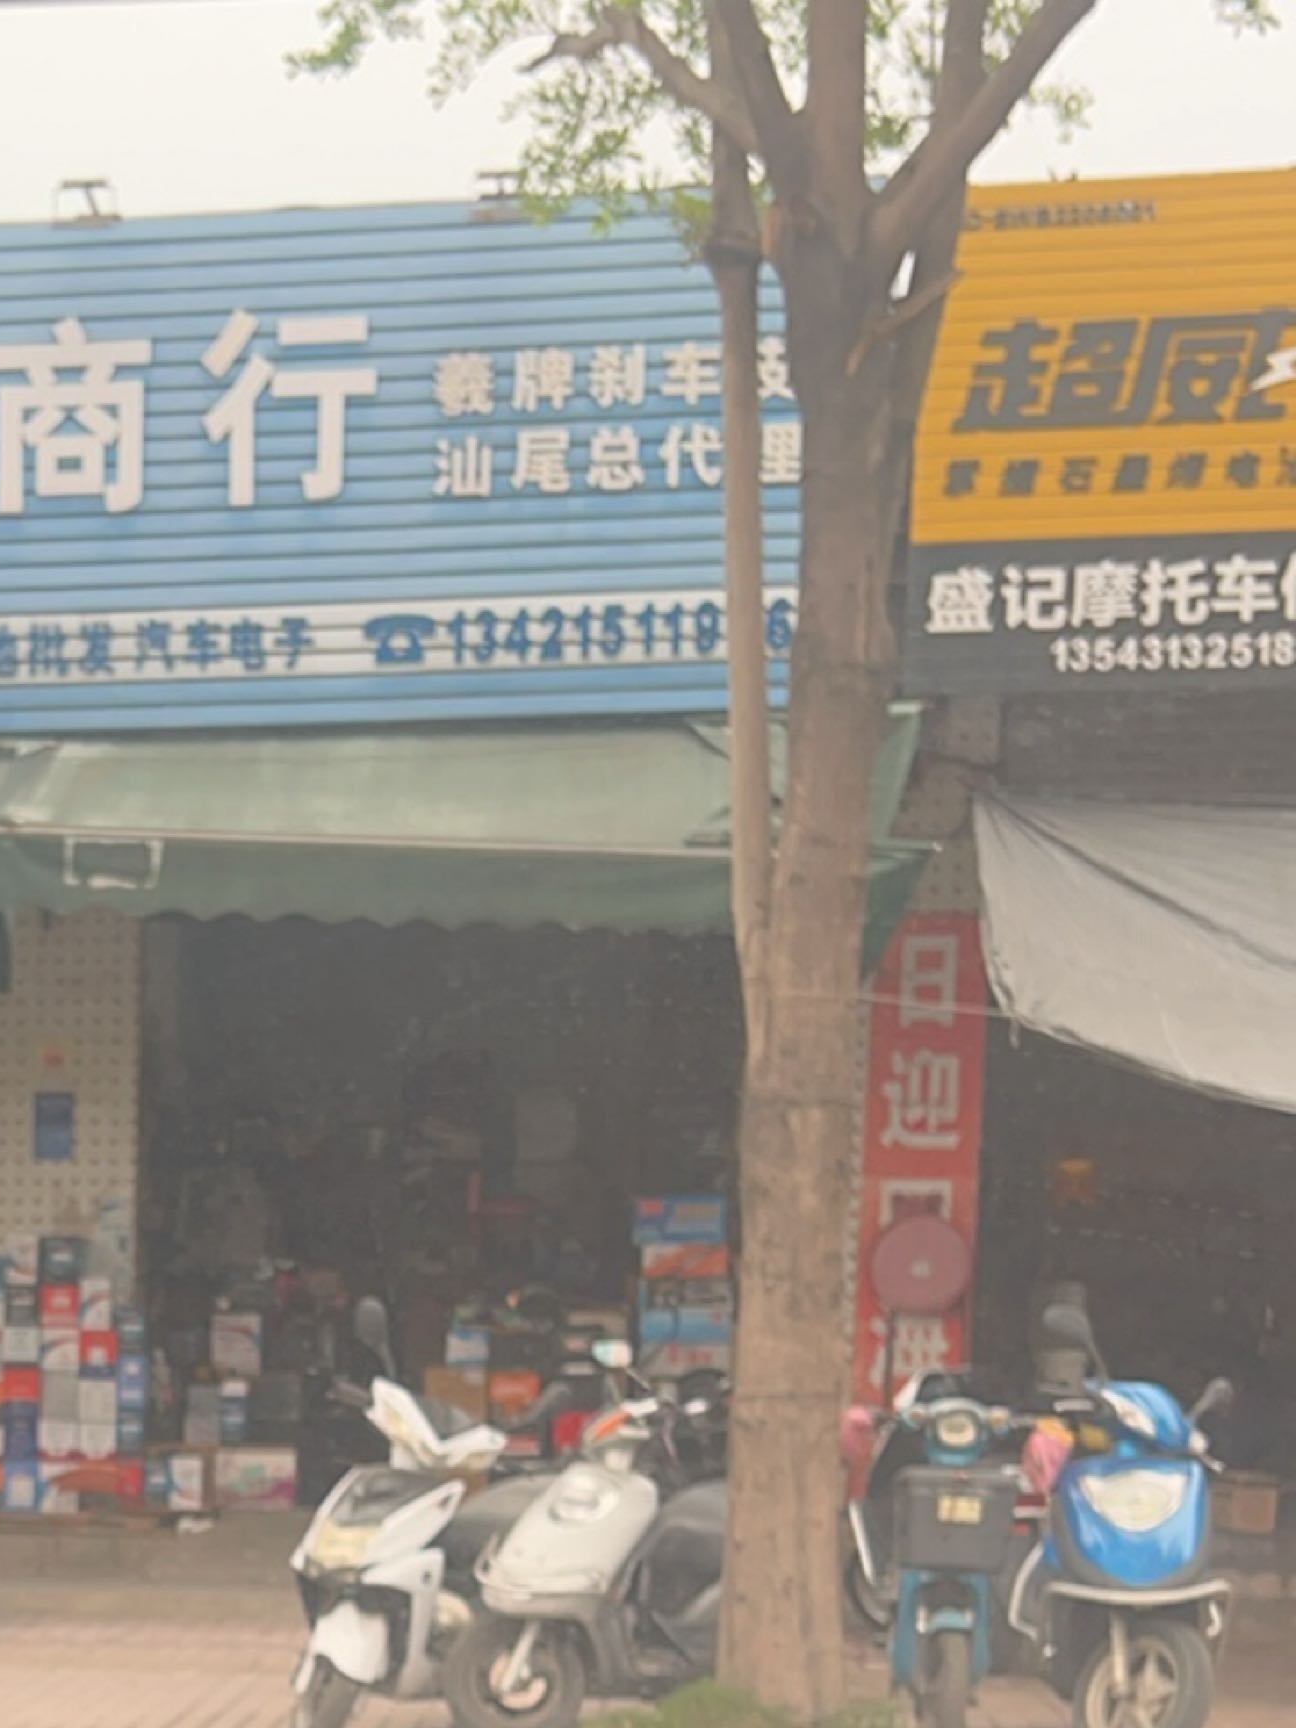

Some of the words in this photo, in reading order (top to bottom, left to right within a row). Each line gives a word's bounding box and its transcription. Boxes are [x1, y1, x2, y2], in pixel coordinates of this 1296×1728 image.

[925, 552, 1296, 634] 盛记摩托车
[1049, 631, 1296, 674] 13543132518
